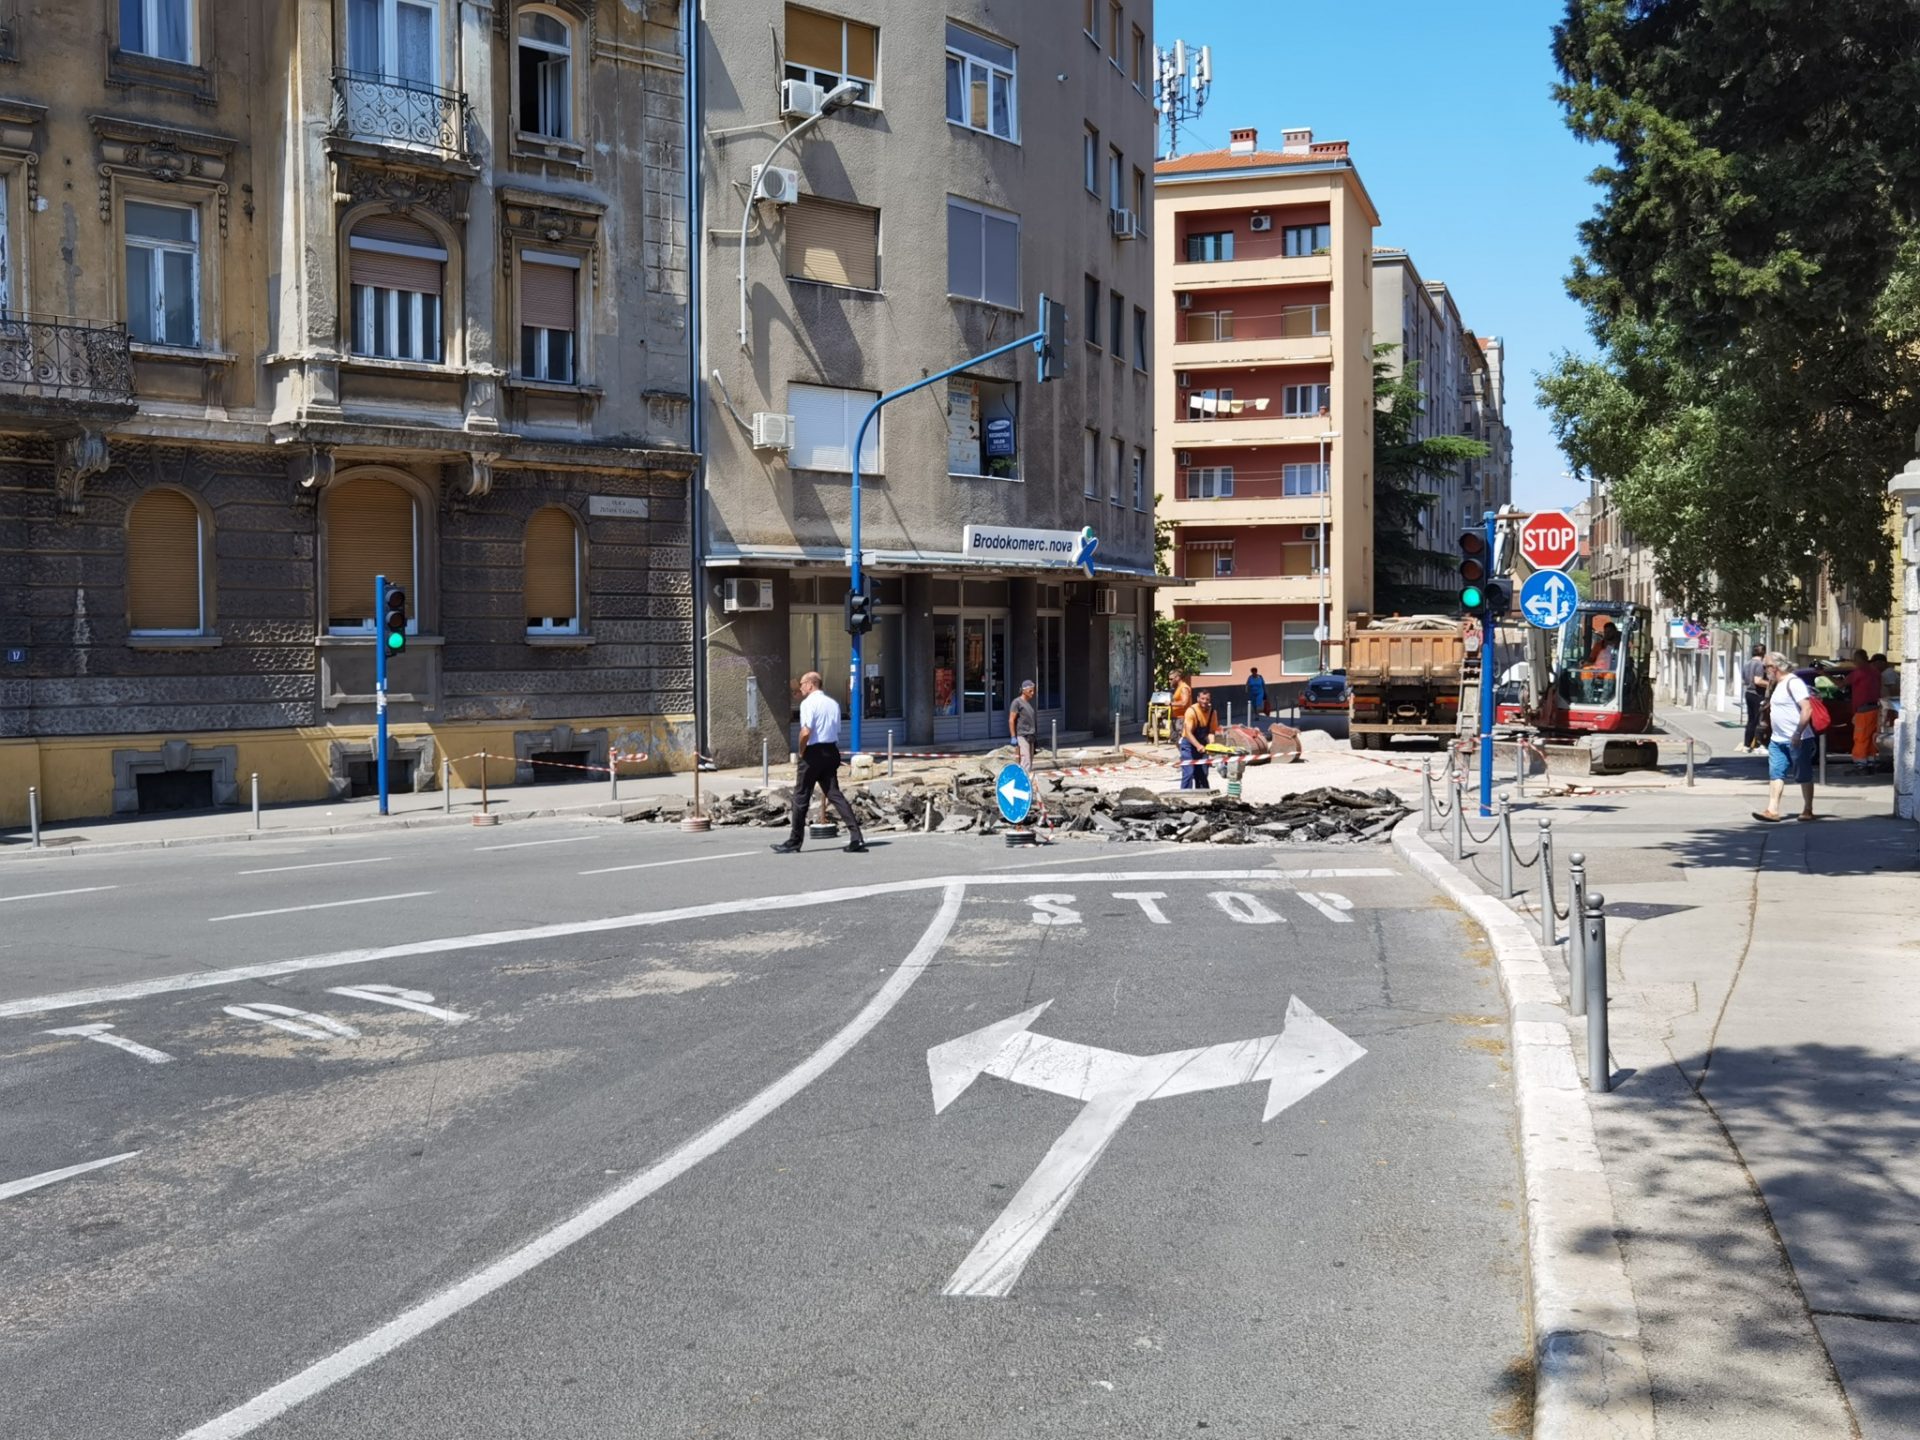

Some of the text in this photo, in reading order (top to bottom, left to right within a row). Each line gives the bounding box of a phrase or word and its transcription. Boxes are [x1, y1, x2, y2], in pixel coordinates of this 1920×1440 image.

[973, 533, 1073, 553] Brodokomerc.nova
[1524, 528, 1574, 552] STOP
[1028, 891, 1354, 925] STOP
